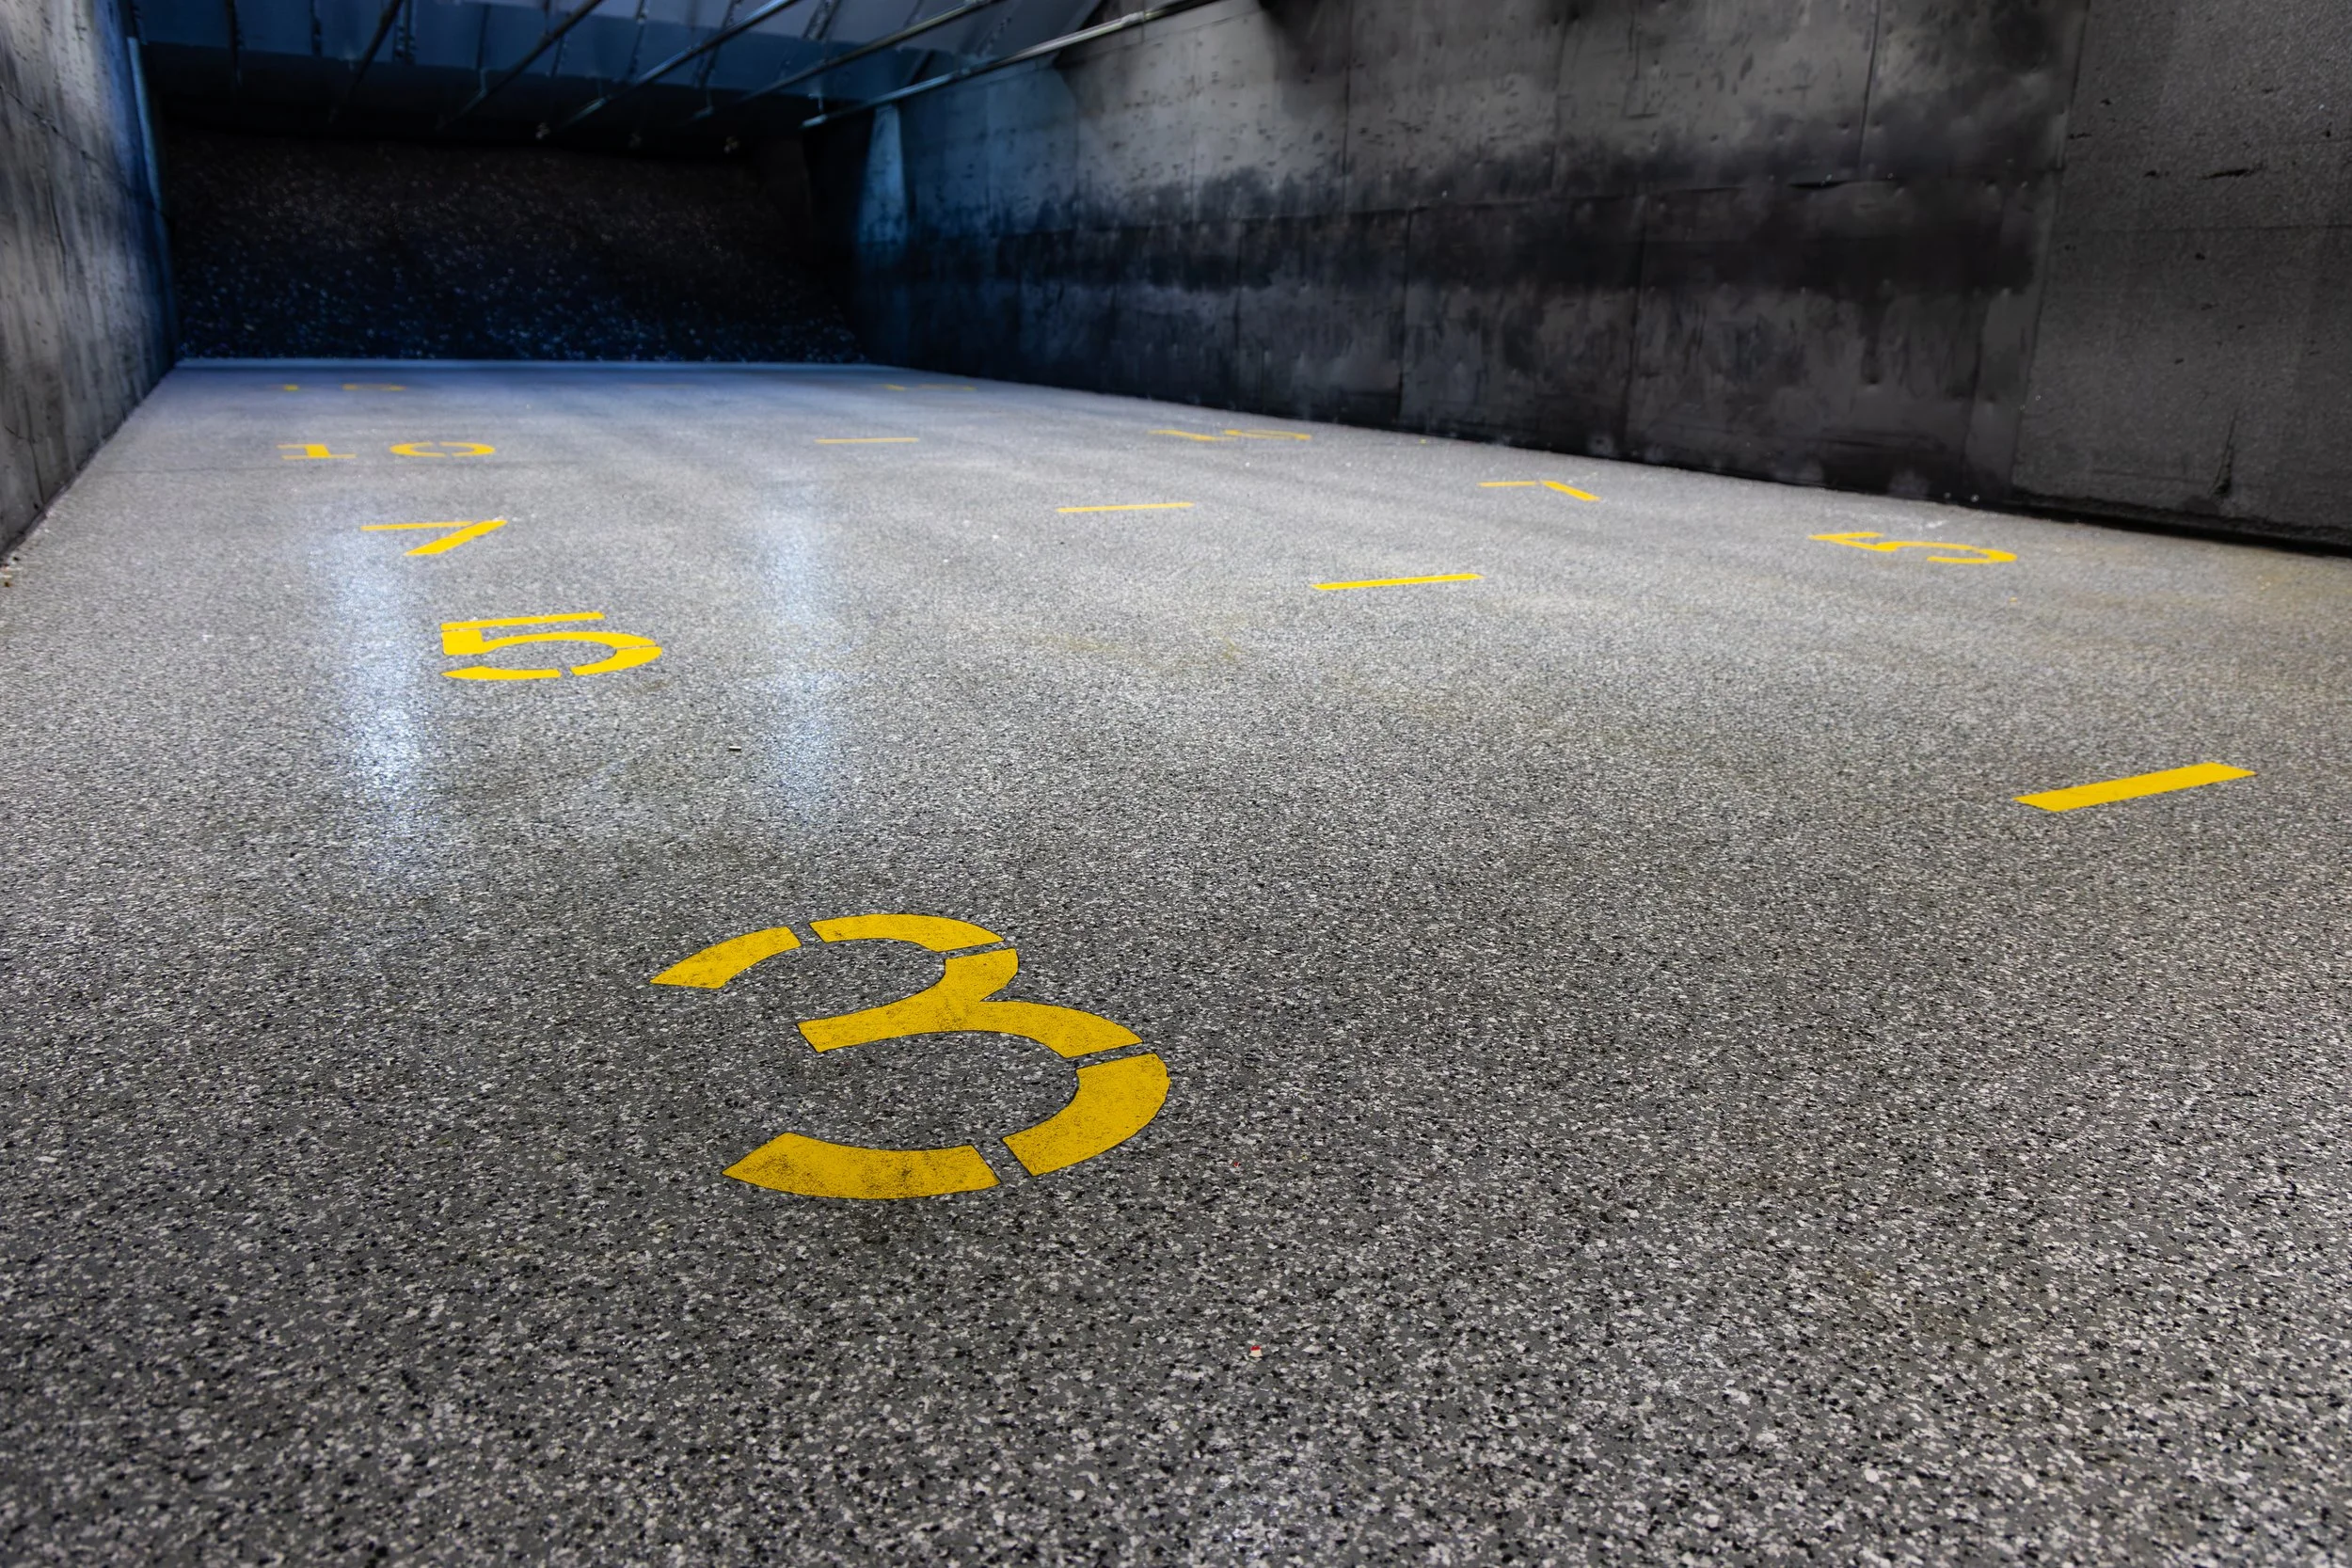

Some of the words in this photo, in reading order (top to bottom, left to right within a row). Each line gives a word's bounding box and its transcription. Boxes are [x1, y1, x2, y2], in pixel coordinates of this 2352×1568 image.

[278, 441, 496, 460] 10
[361, 516, 508, 556] 7
[1808, 531, 2019, 564] 5
[439, 610, 663, 682] 5
[649, 912, 1172, 1200] 3
